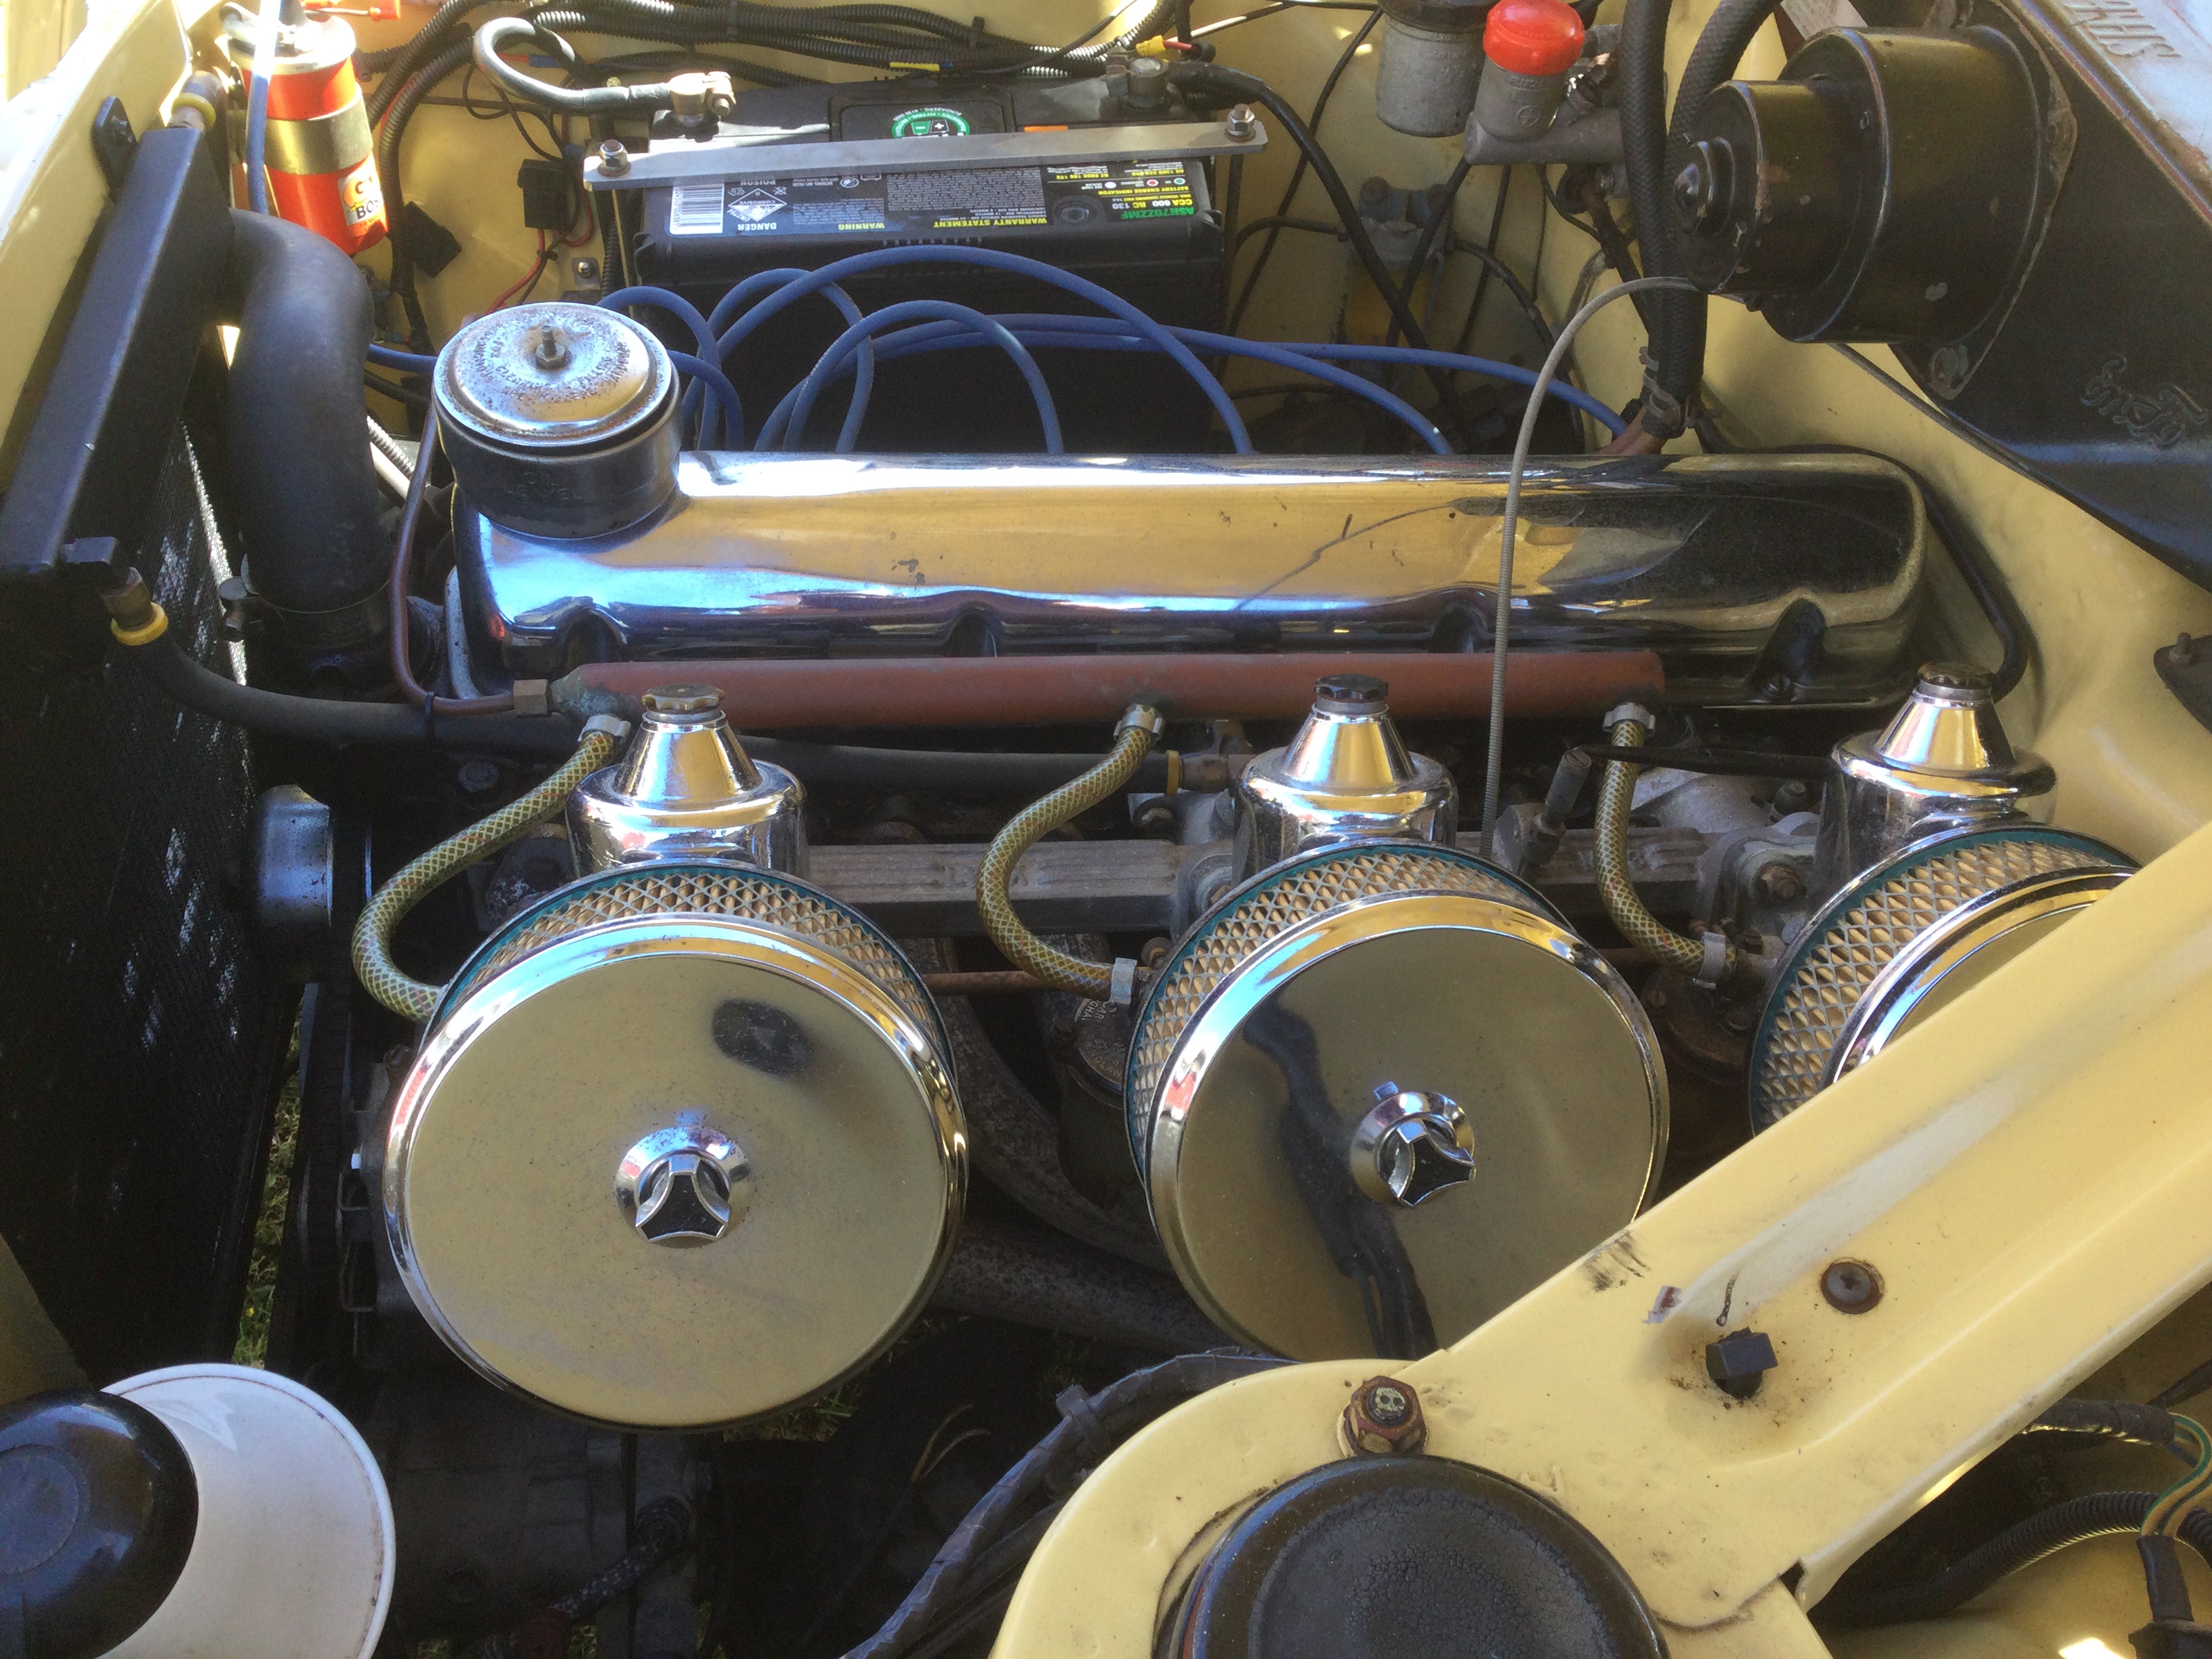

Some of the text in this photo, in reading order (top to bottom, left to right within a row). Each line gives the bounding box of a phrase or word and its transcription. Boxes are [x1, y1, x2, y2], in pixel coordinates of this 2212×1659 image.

[1121, 207, 1194, 220] ASN70ZZMF
[737, 222, 777, 230] DANGER
[838, 222, 885, 230] WARNING
[933, 220, 991, 228] STATEMENT
